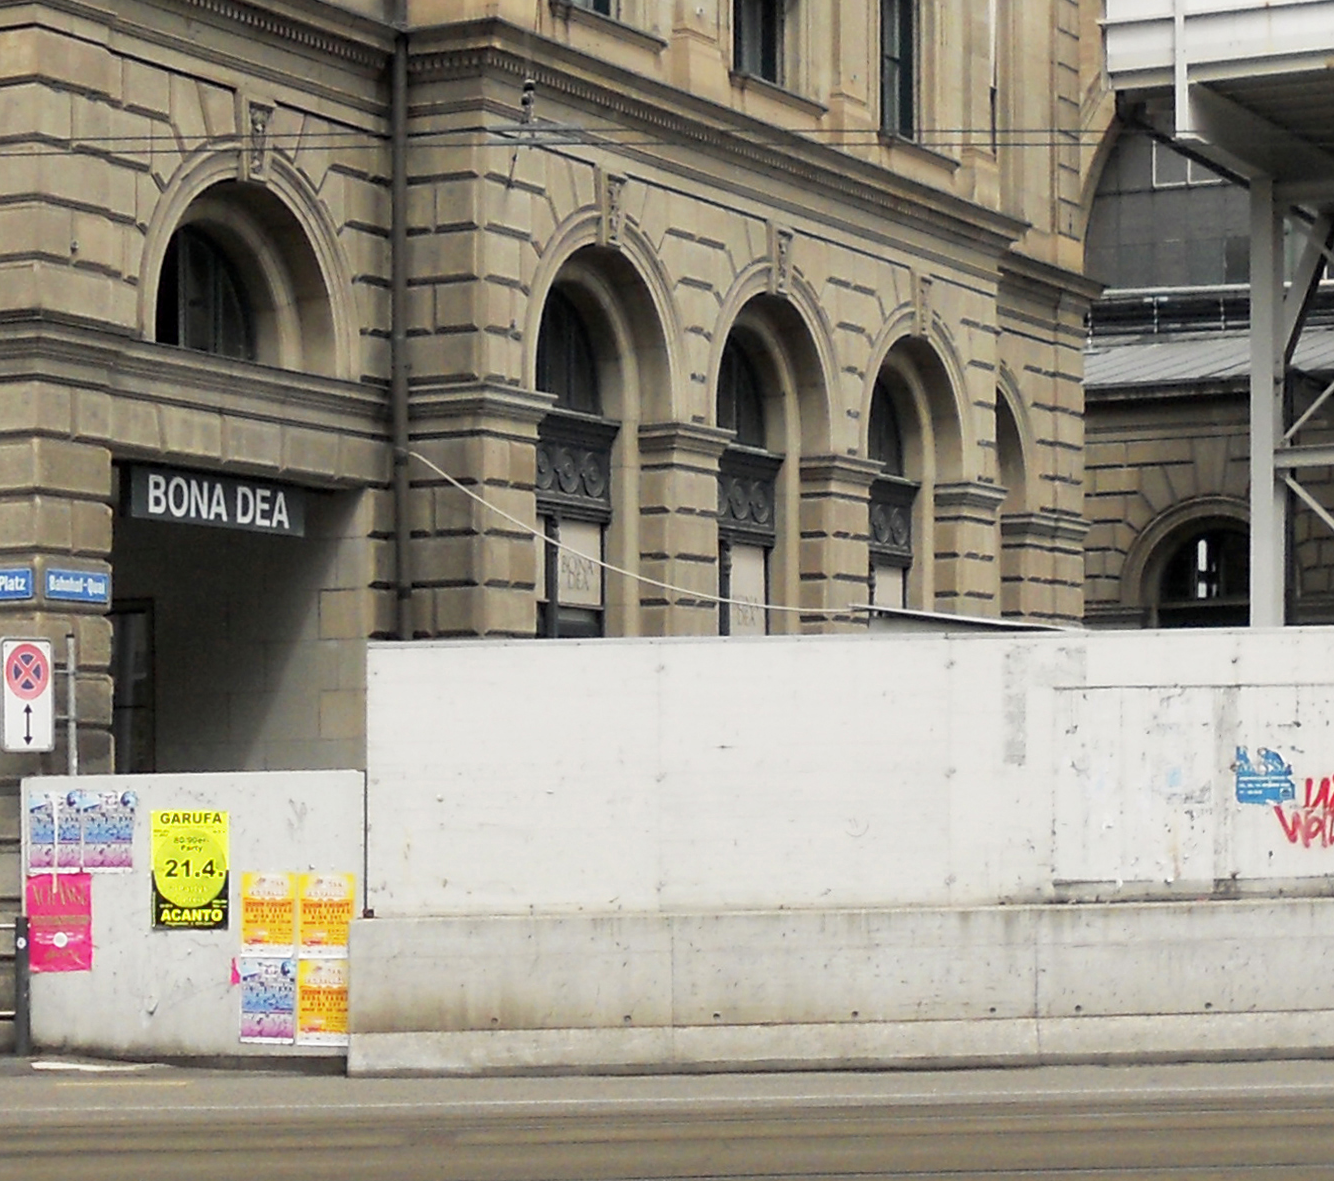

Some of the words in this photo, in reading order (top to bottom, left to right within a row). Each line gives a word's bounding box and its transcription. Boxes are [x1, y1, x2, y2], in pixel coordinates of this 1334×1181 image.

[148, 474, 228, 522] BONA
[236, 486, 290, 529] DEA
[160, 812, 222, 824] GARUFA
[165, 859, 224, 878] 21.4.
[160, 908, 223, 922] ACANTO
